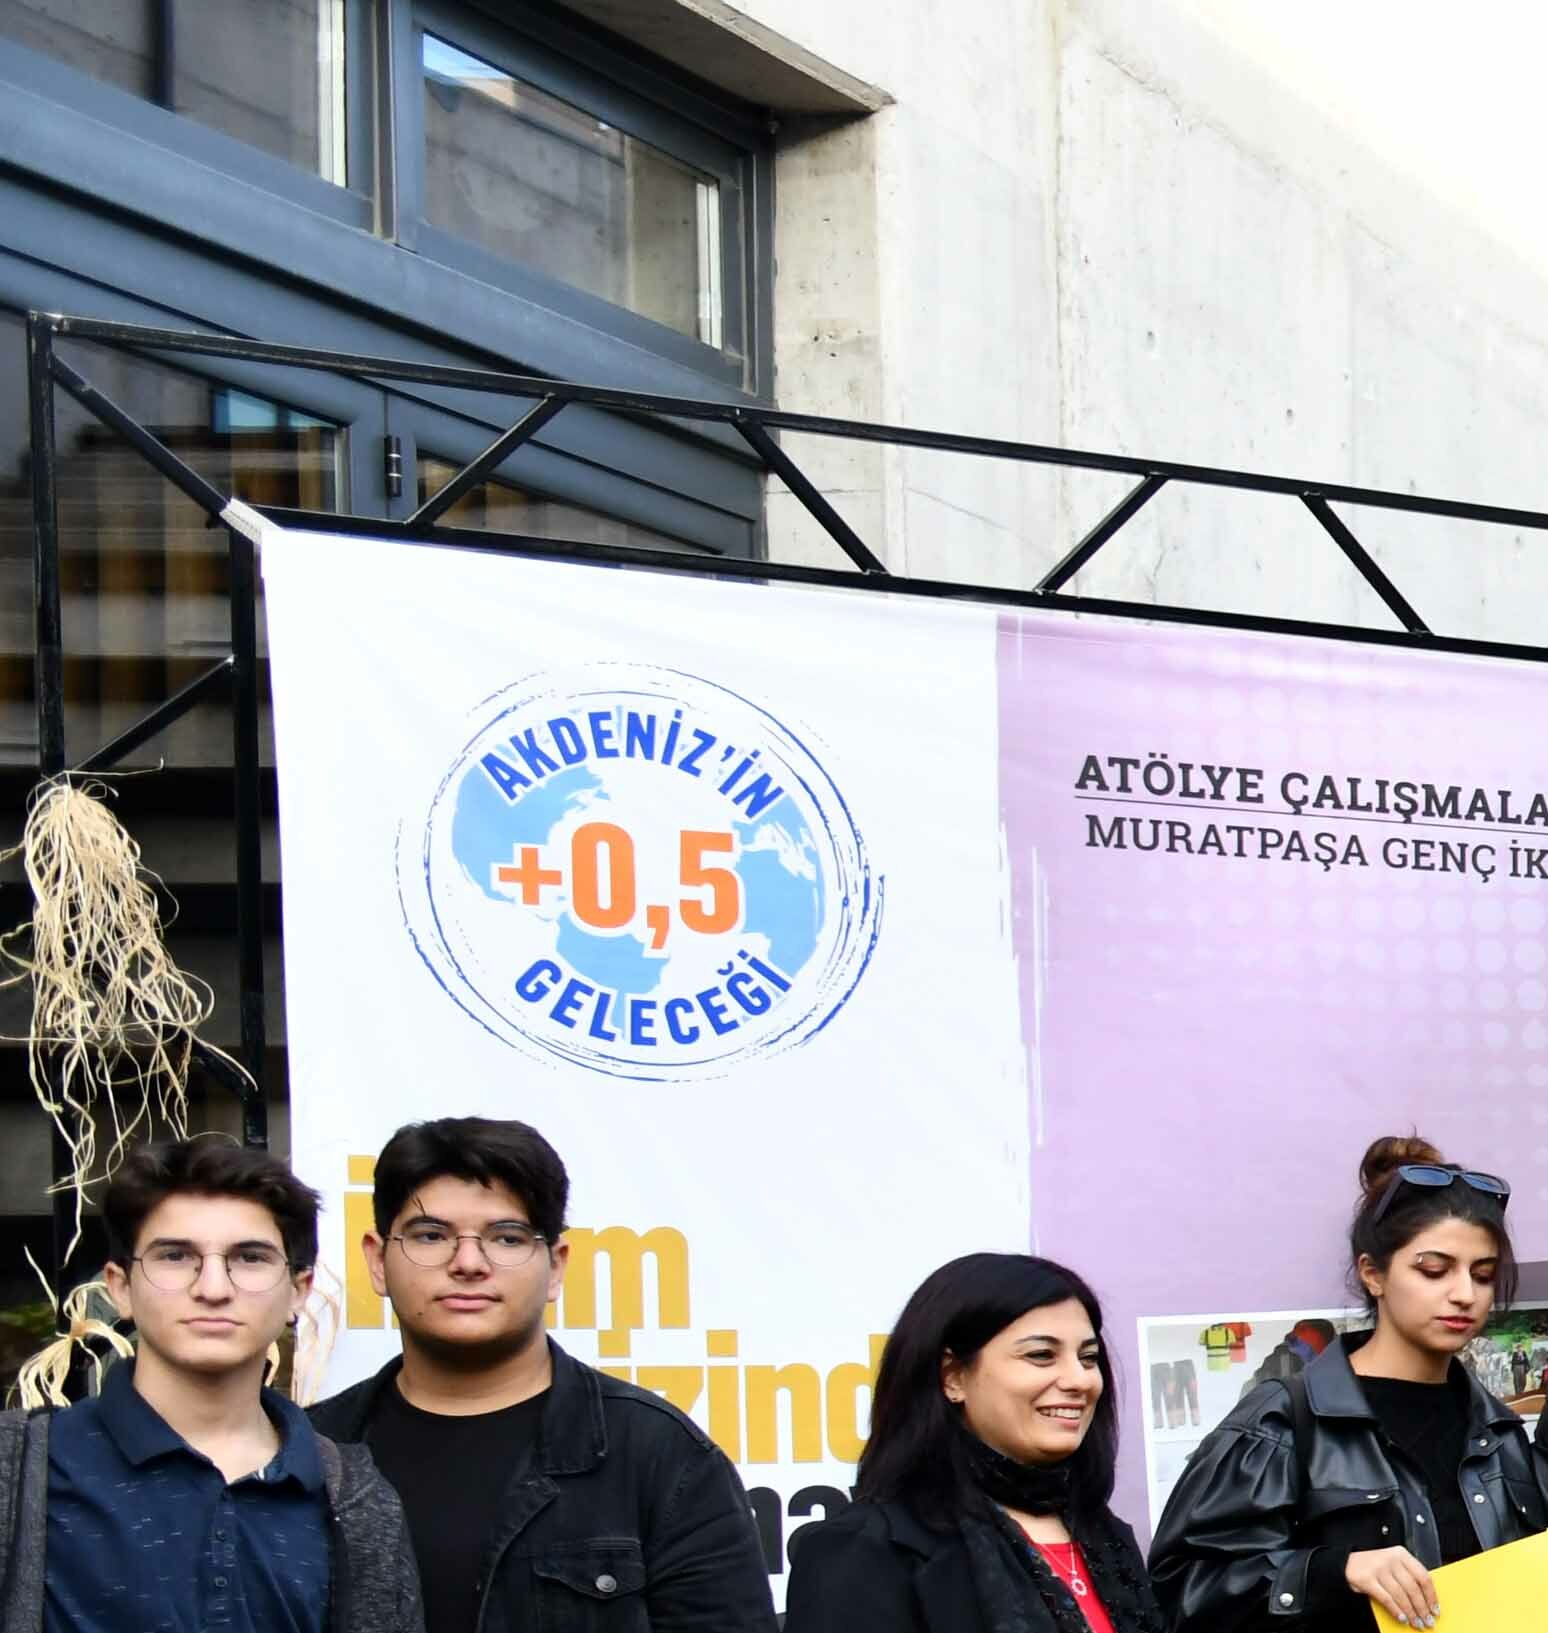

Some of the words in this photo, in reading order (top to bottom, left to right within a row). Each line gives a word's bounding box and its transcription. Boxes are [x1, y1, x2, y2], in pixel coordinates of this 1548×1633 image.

[1074, 752, 1264, 803] ATÖLYE
[498, 822, 741, 950] +0,5
[1085, 814, 1369, 872] MURATPAŞA
[1382, 836, 1496, 883] GENÇ
[514, 949, 793, 1047] GELECEĞİ
